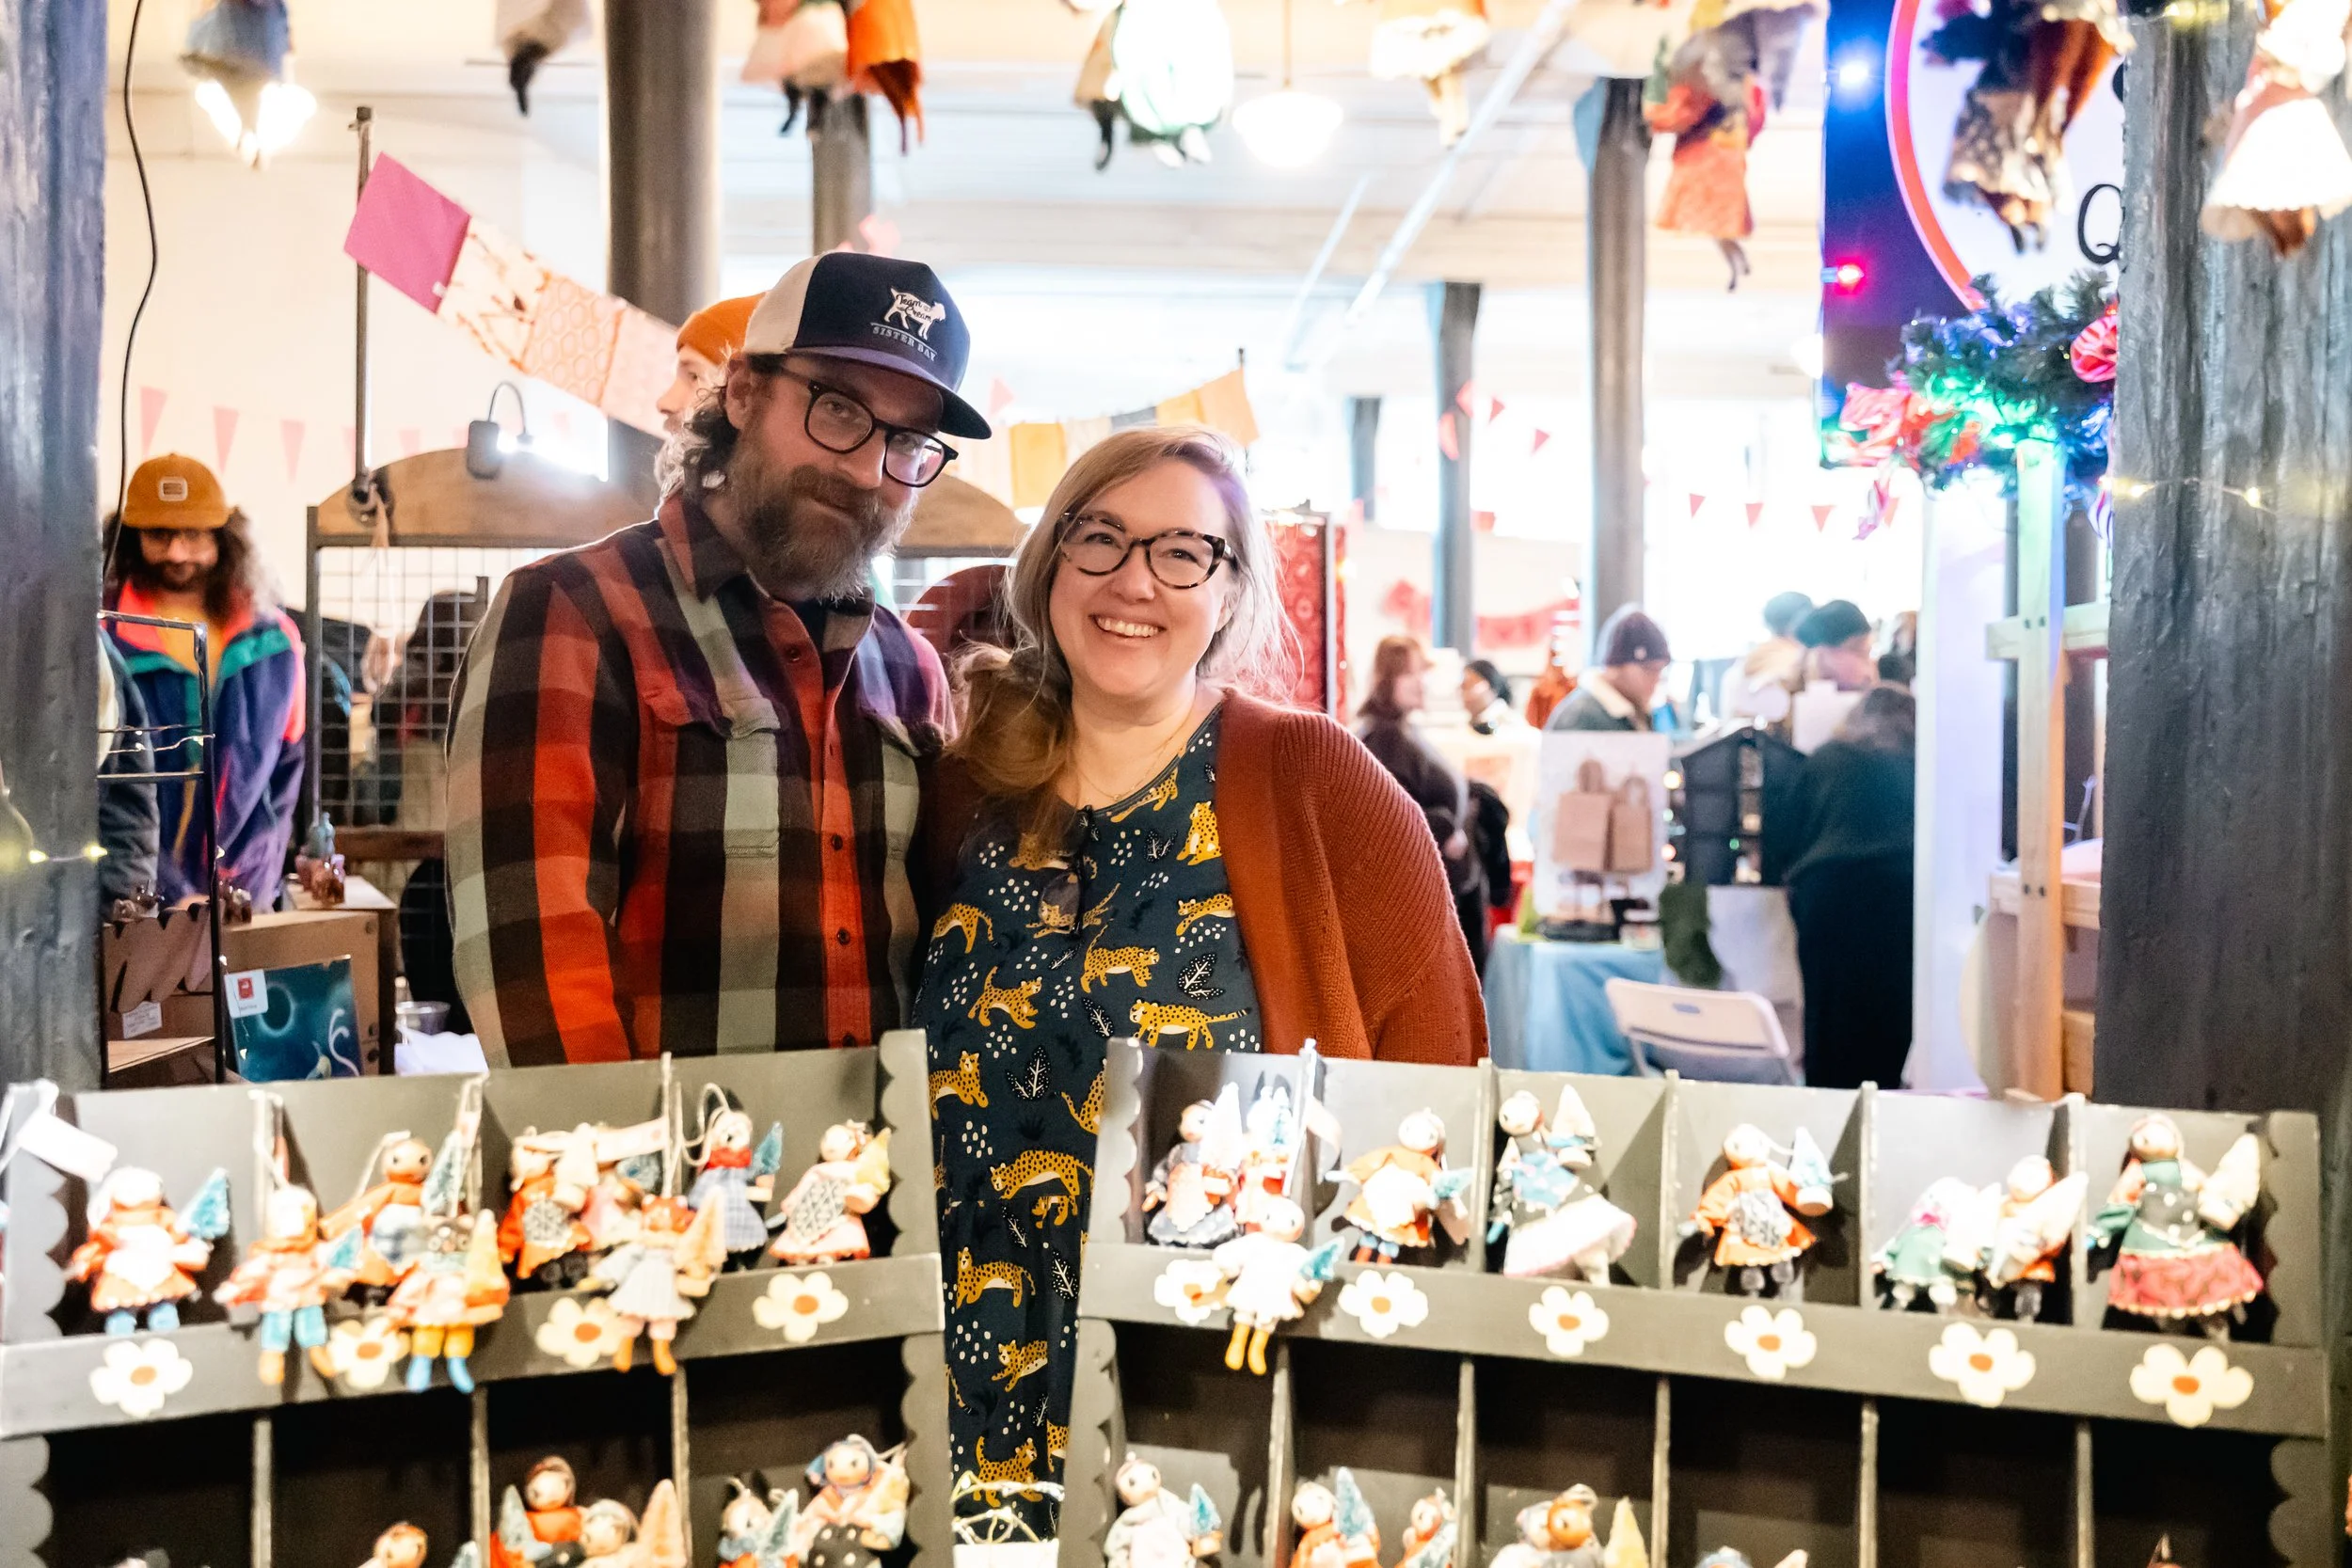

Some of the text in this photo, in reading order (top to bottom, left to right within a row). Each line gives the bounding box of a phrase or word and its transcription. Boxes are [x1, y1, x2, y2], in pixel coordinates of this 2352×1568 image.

[895, 293, 923, 308] Team
[872, 326, 937, 362] SISTER BAY
